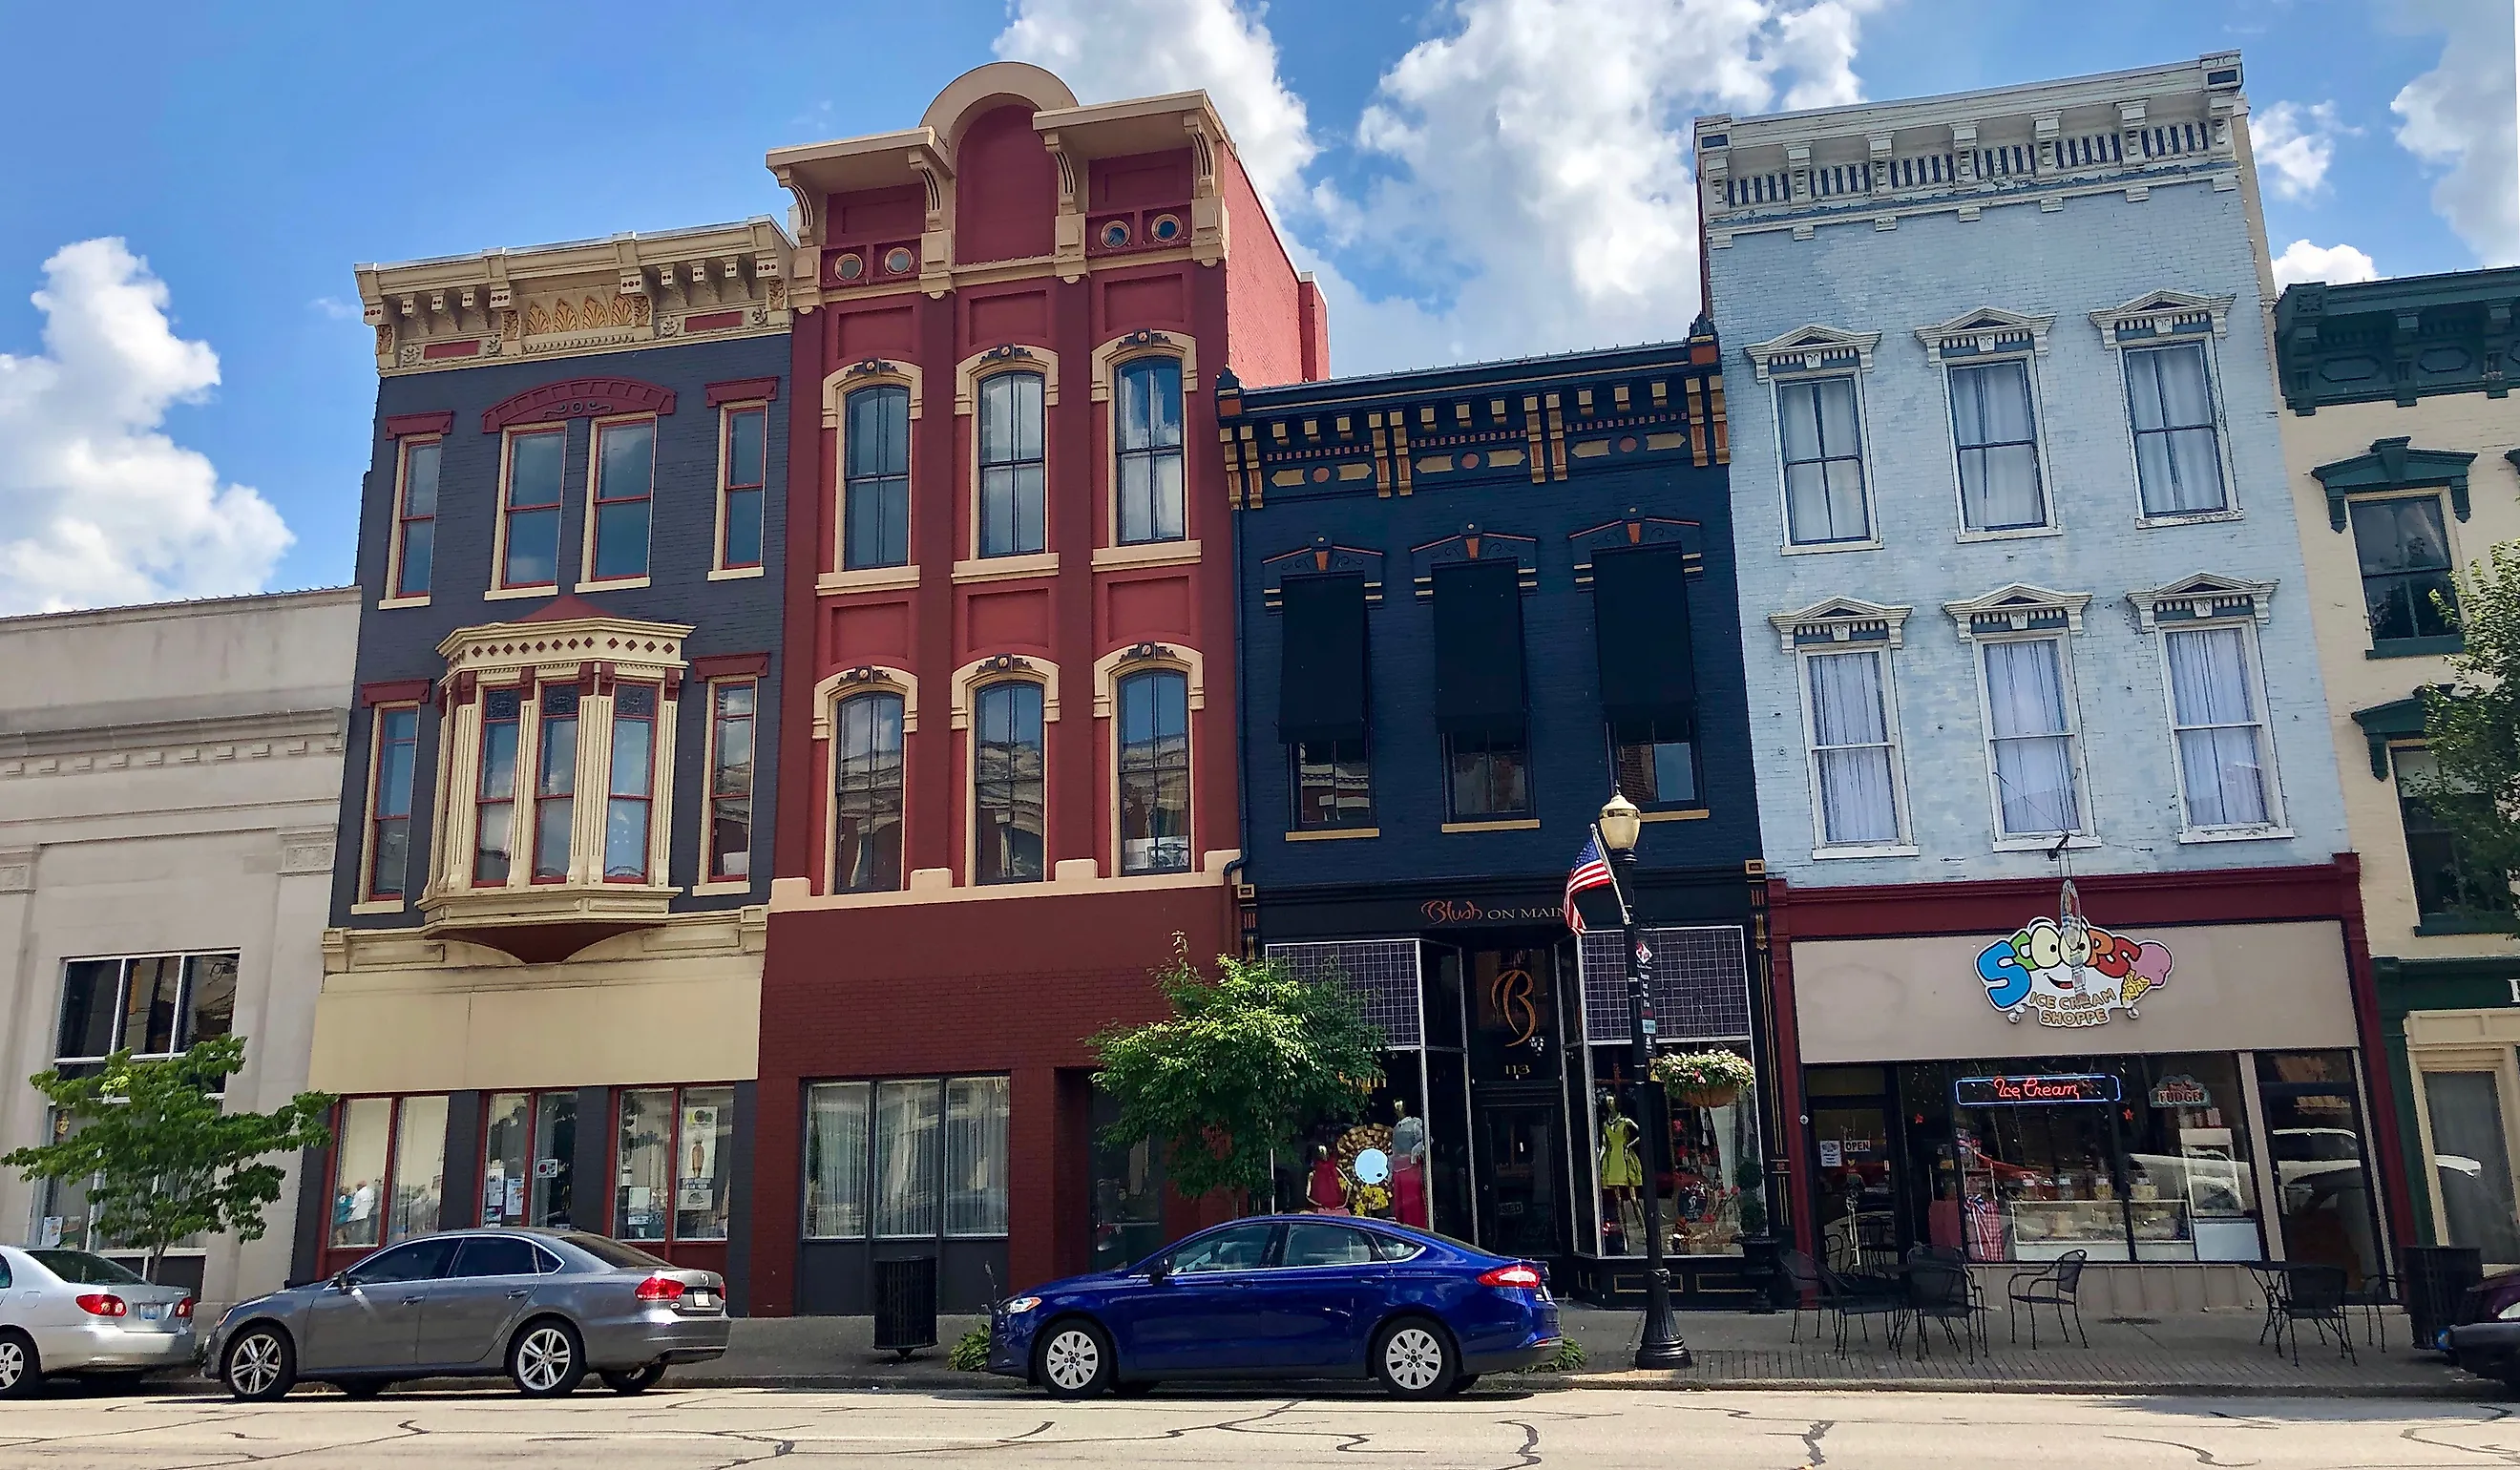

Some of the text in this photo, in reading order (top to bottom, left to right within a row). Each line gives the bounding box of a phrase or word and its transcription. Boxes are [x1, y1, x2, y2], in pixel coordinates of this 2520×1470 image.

[1420, 900, 1566, 924] Blush ON MAIN
[1976, 925, 2143, 1009] SCOOPS
[1490, 969, 1536, 1047] B
[2029, 991, 2057, 1009] ICE
[2041, 1008, 2108, 1025] SHOPPE
[1505, 1064, 1530, 1075] 113
[1993, 1076, 2080, 1101] Ice Cream
[2158, 1089, 2202, 1105] FUDGE
[1845, 1141, 1870, 1151] OPEN
